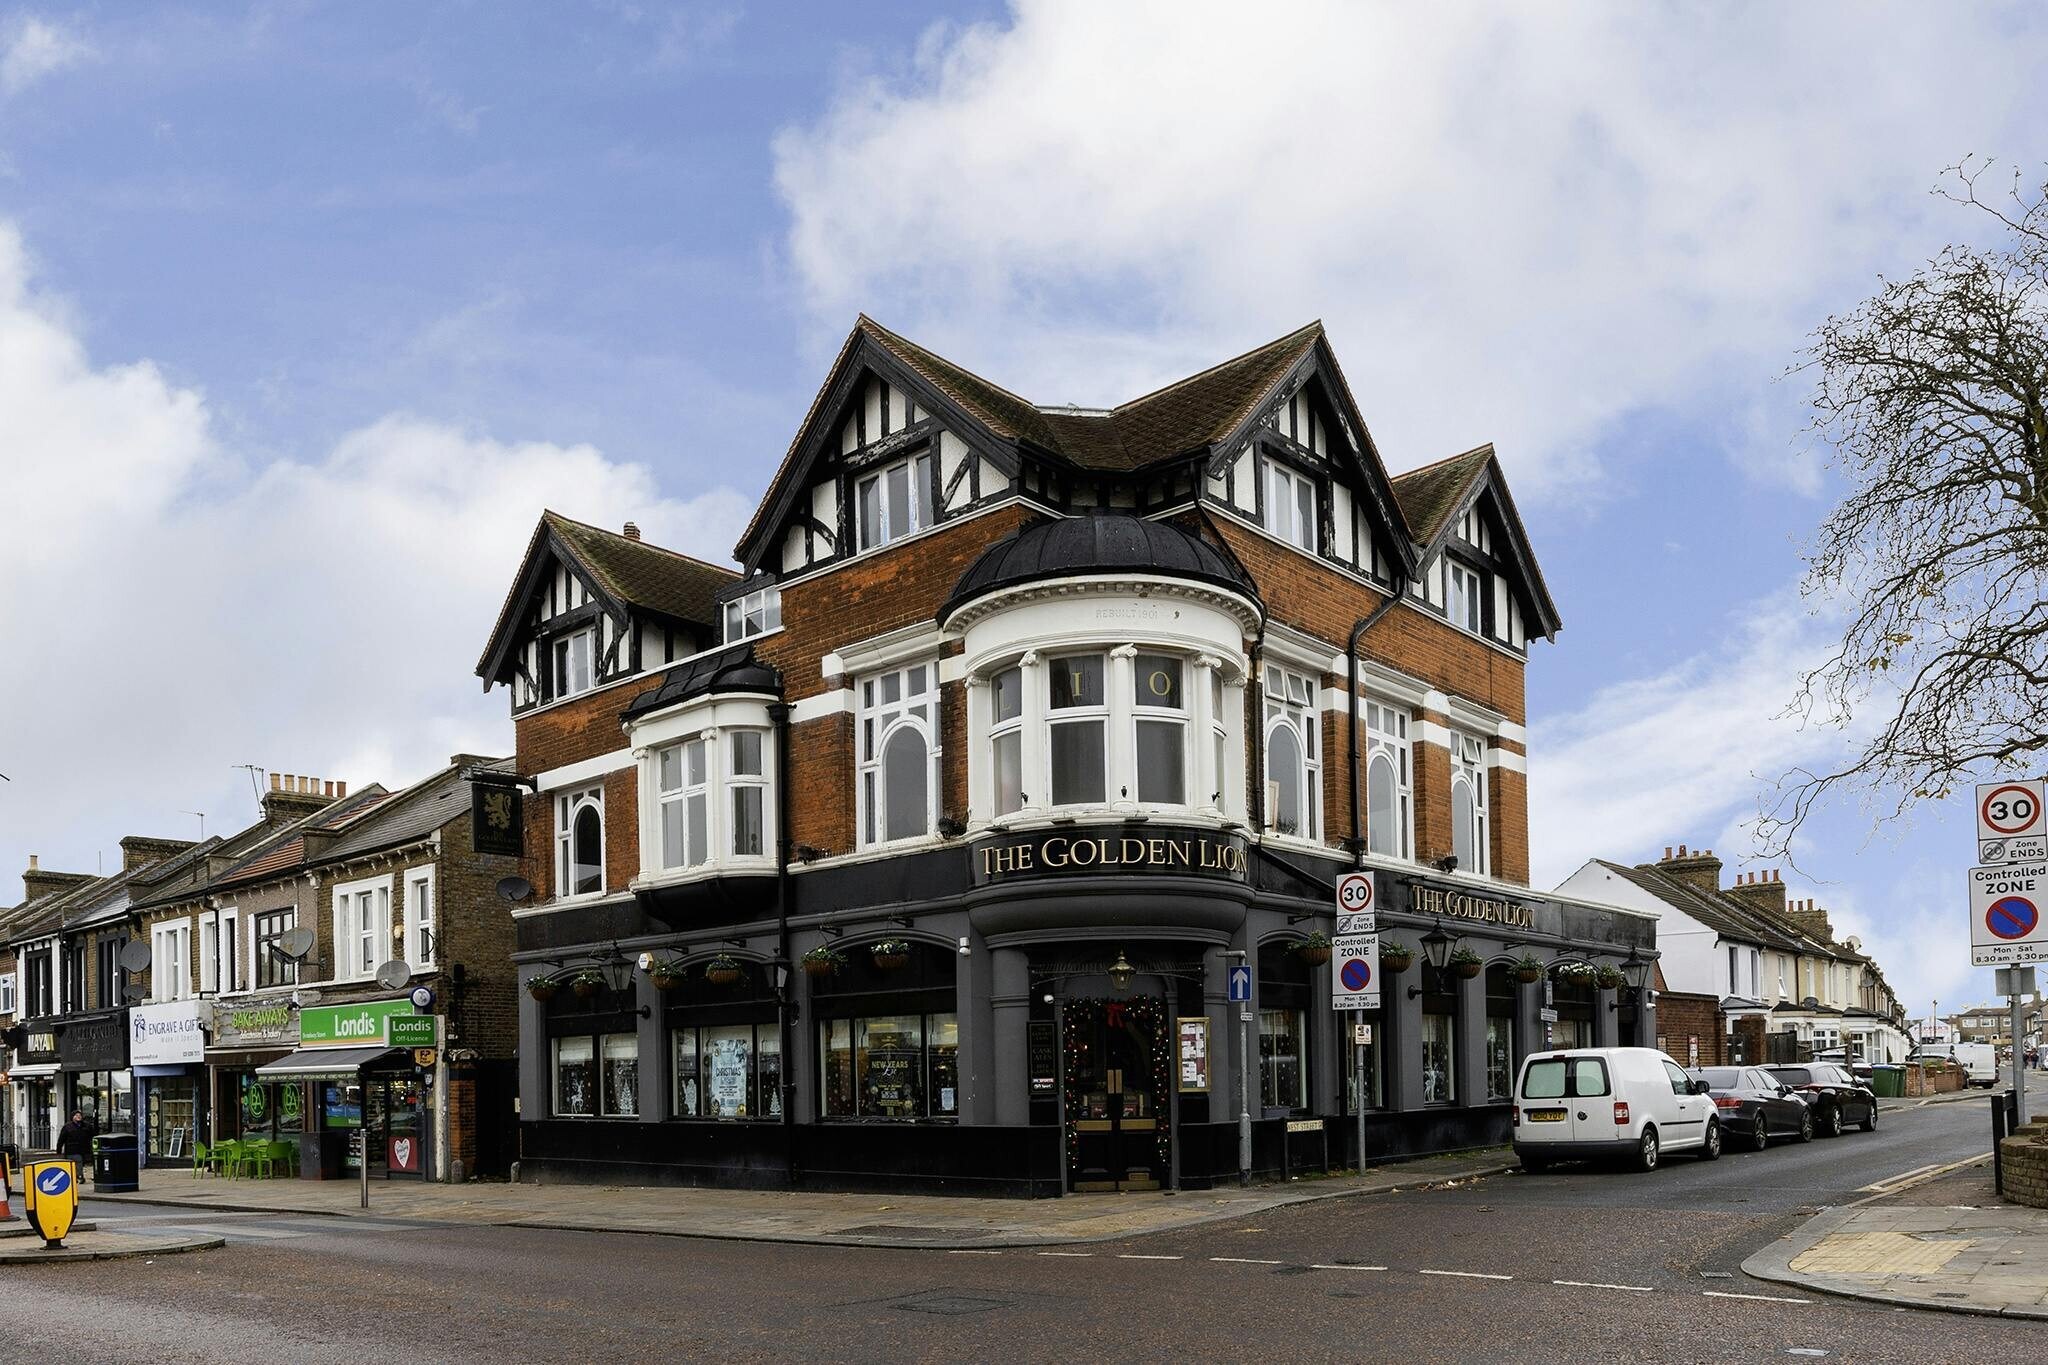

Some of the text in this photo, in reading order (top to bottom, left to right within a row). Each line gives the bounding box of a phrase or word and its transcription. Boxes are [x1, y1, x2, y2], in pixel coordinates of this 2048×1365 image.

[1991, 799, 2031, 820] 30
[979, 837, 1248, 875] THE GOLDEN LION
[2010, 848, 2045, 858] ENDS
[1974, 865, 2046, 881] Controlled
[1343, 885, 1367, 902] 30
[1985, 879, 2036, 895] ZONE
[1412, 884, 1535, 928] THE GOLDEN LION
[1353, 922, 1374, 931] ENDS
[1334, 936, 1376, 947] Controlled
[1340, 946, 1370, 958] ZONE
[1976, 955, 1996, 963] 8.30
[148, 1021, 178, 1035] ENGRAVE
[179, 1020, 184, 1032] A
[334, 1012, 376, 1037] Londis
[392, 1020, 432, 1032] Londis
[871, 1060, 909, 1069] NEW YEARS
[715, 1067, 742, 1077] CHRISTMAS
